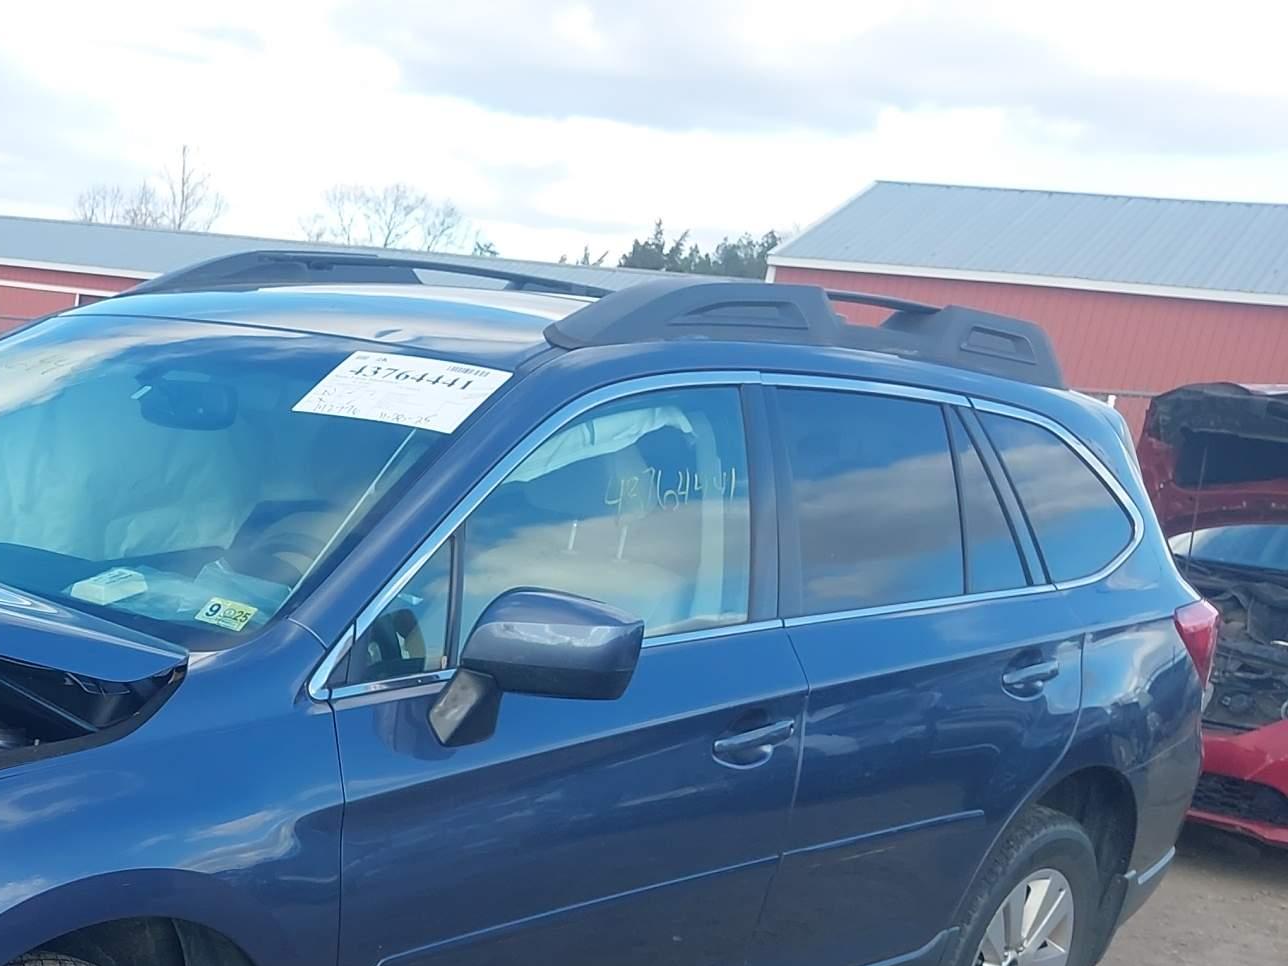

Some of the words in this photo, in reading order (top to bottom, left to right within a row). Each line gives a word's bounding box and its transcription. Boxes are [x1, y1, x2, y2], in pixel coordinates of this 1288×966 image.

[348, 364, 474, 391] 43764441
[205, 603, 222, 618] 9
[233, 610, 250, 623] 25
